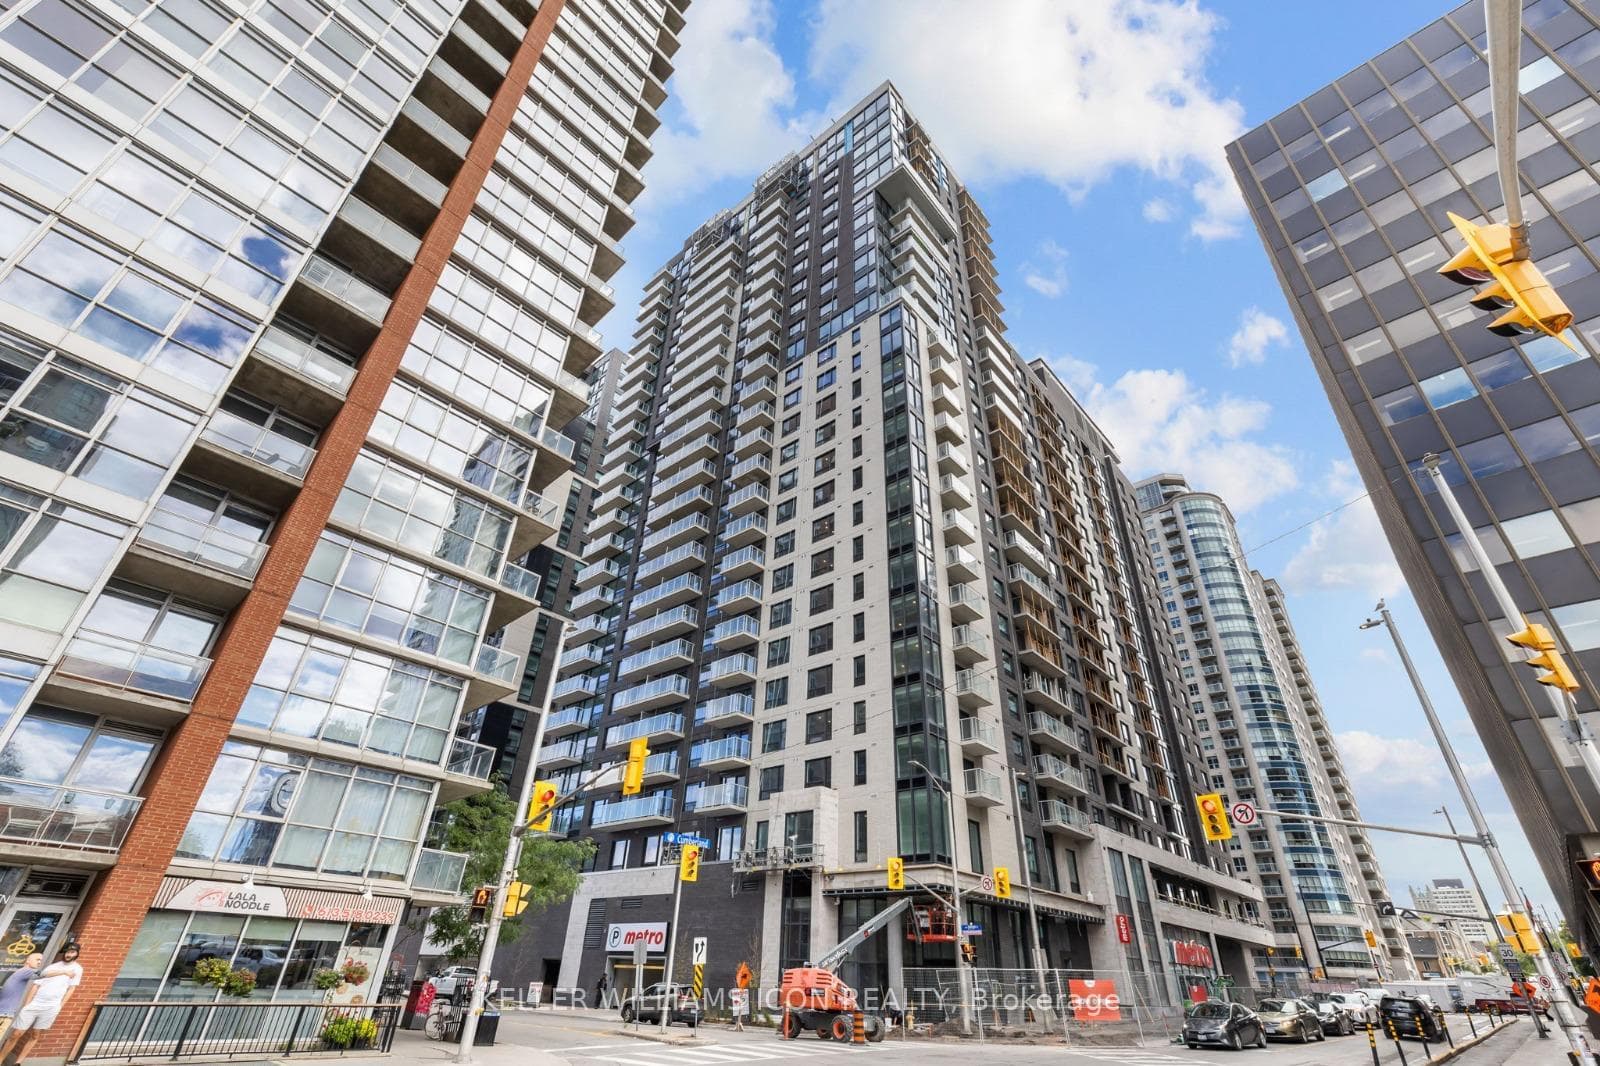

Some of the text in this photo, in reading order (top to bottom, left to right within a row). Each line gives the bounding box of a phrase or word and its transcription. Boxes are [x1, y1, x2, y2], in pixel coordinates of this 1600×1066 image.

[228, 892, 257, 902] LALA
[224, 900, 271, 911] NOODLE
[1119, 916, 1129, 942] metro
[623, 929, 663, 945] metro
[1501, 949, 1514, 957] 30
